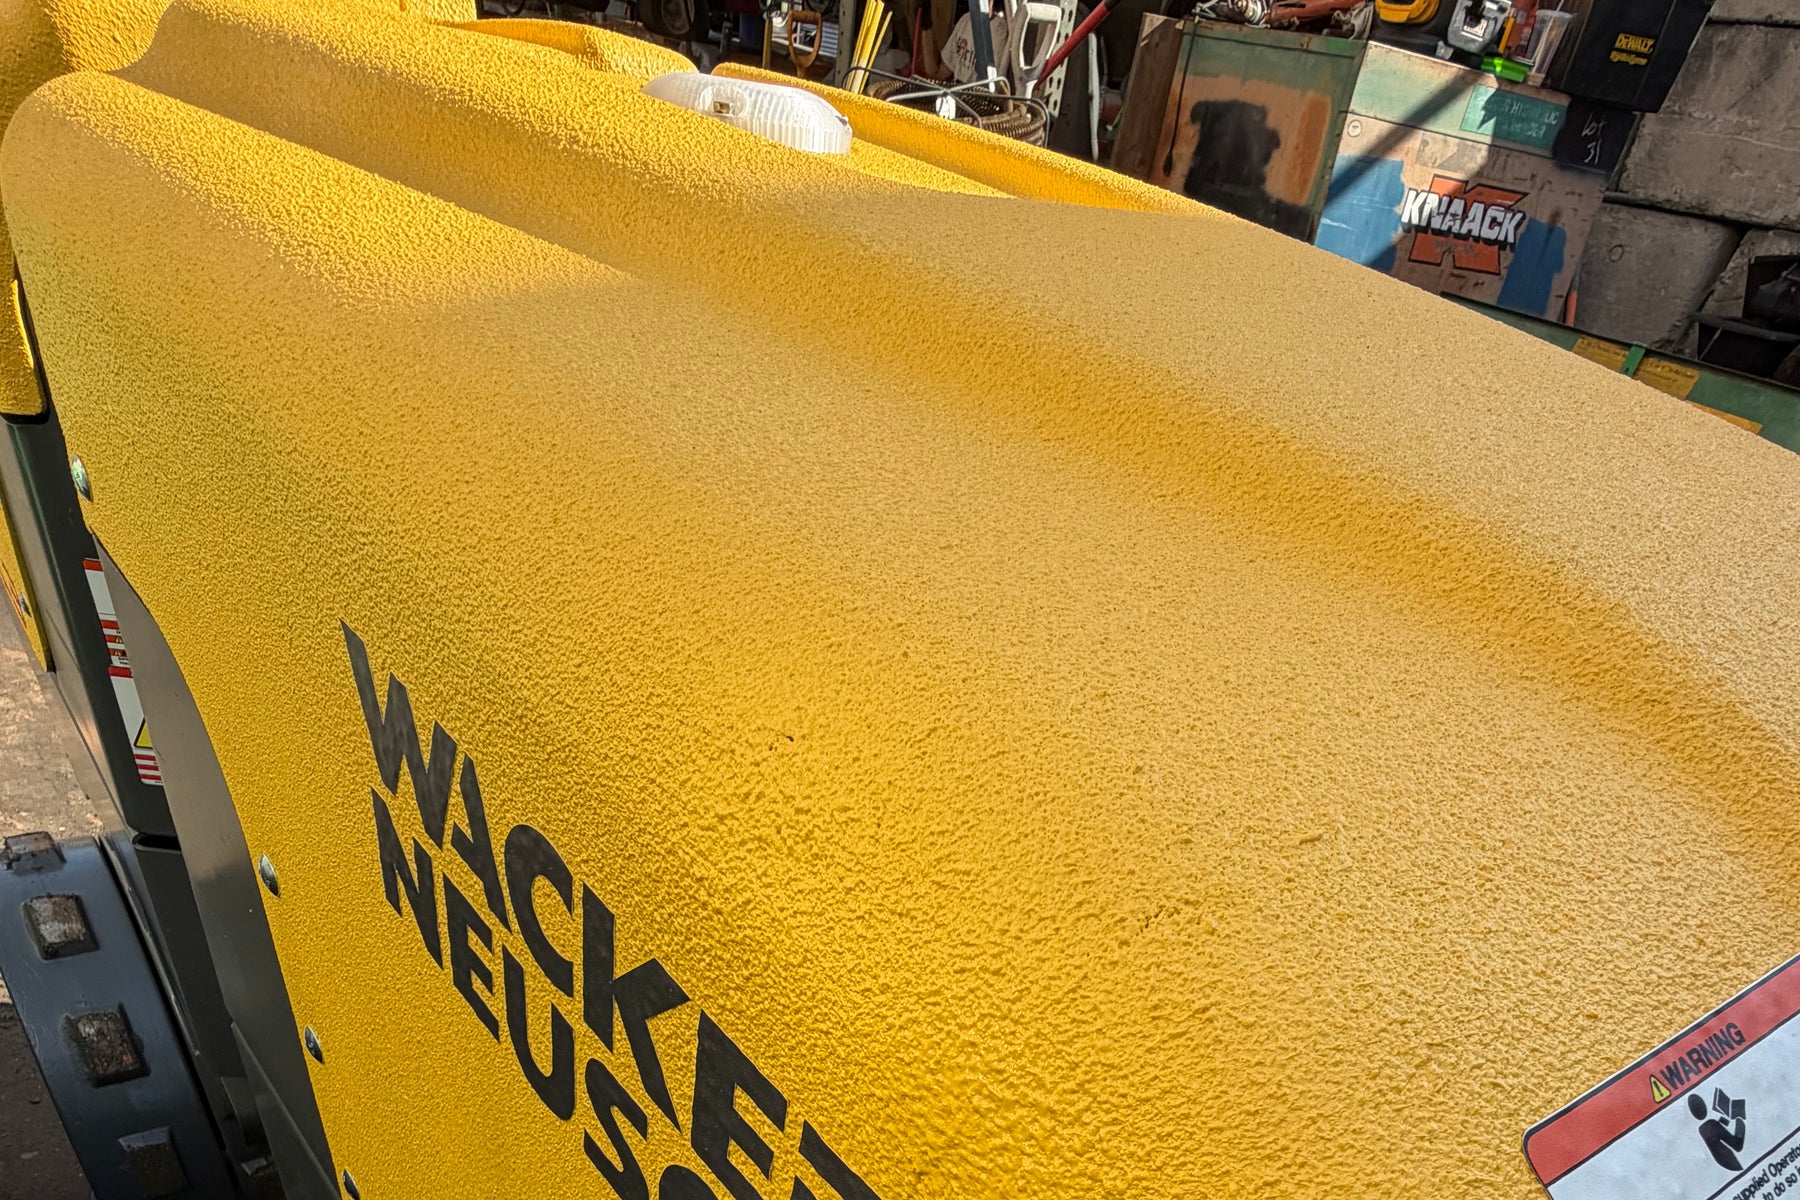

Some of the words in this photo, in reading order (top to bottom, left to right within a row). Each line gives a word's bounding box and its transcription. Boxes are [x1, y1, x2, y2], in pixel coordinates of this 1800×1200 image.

[1400, 188, 1526, 248] KNAACK
[1659, 1022, 1746, 1090] WARNING
[1768, 1144, 1800, 1178] Operato
[1773, 1182, 1787, 1198] do
[1785, 1173, 1798, 1188] so
